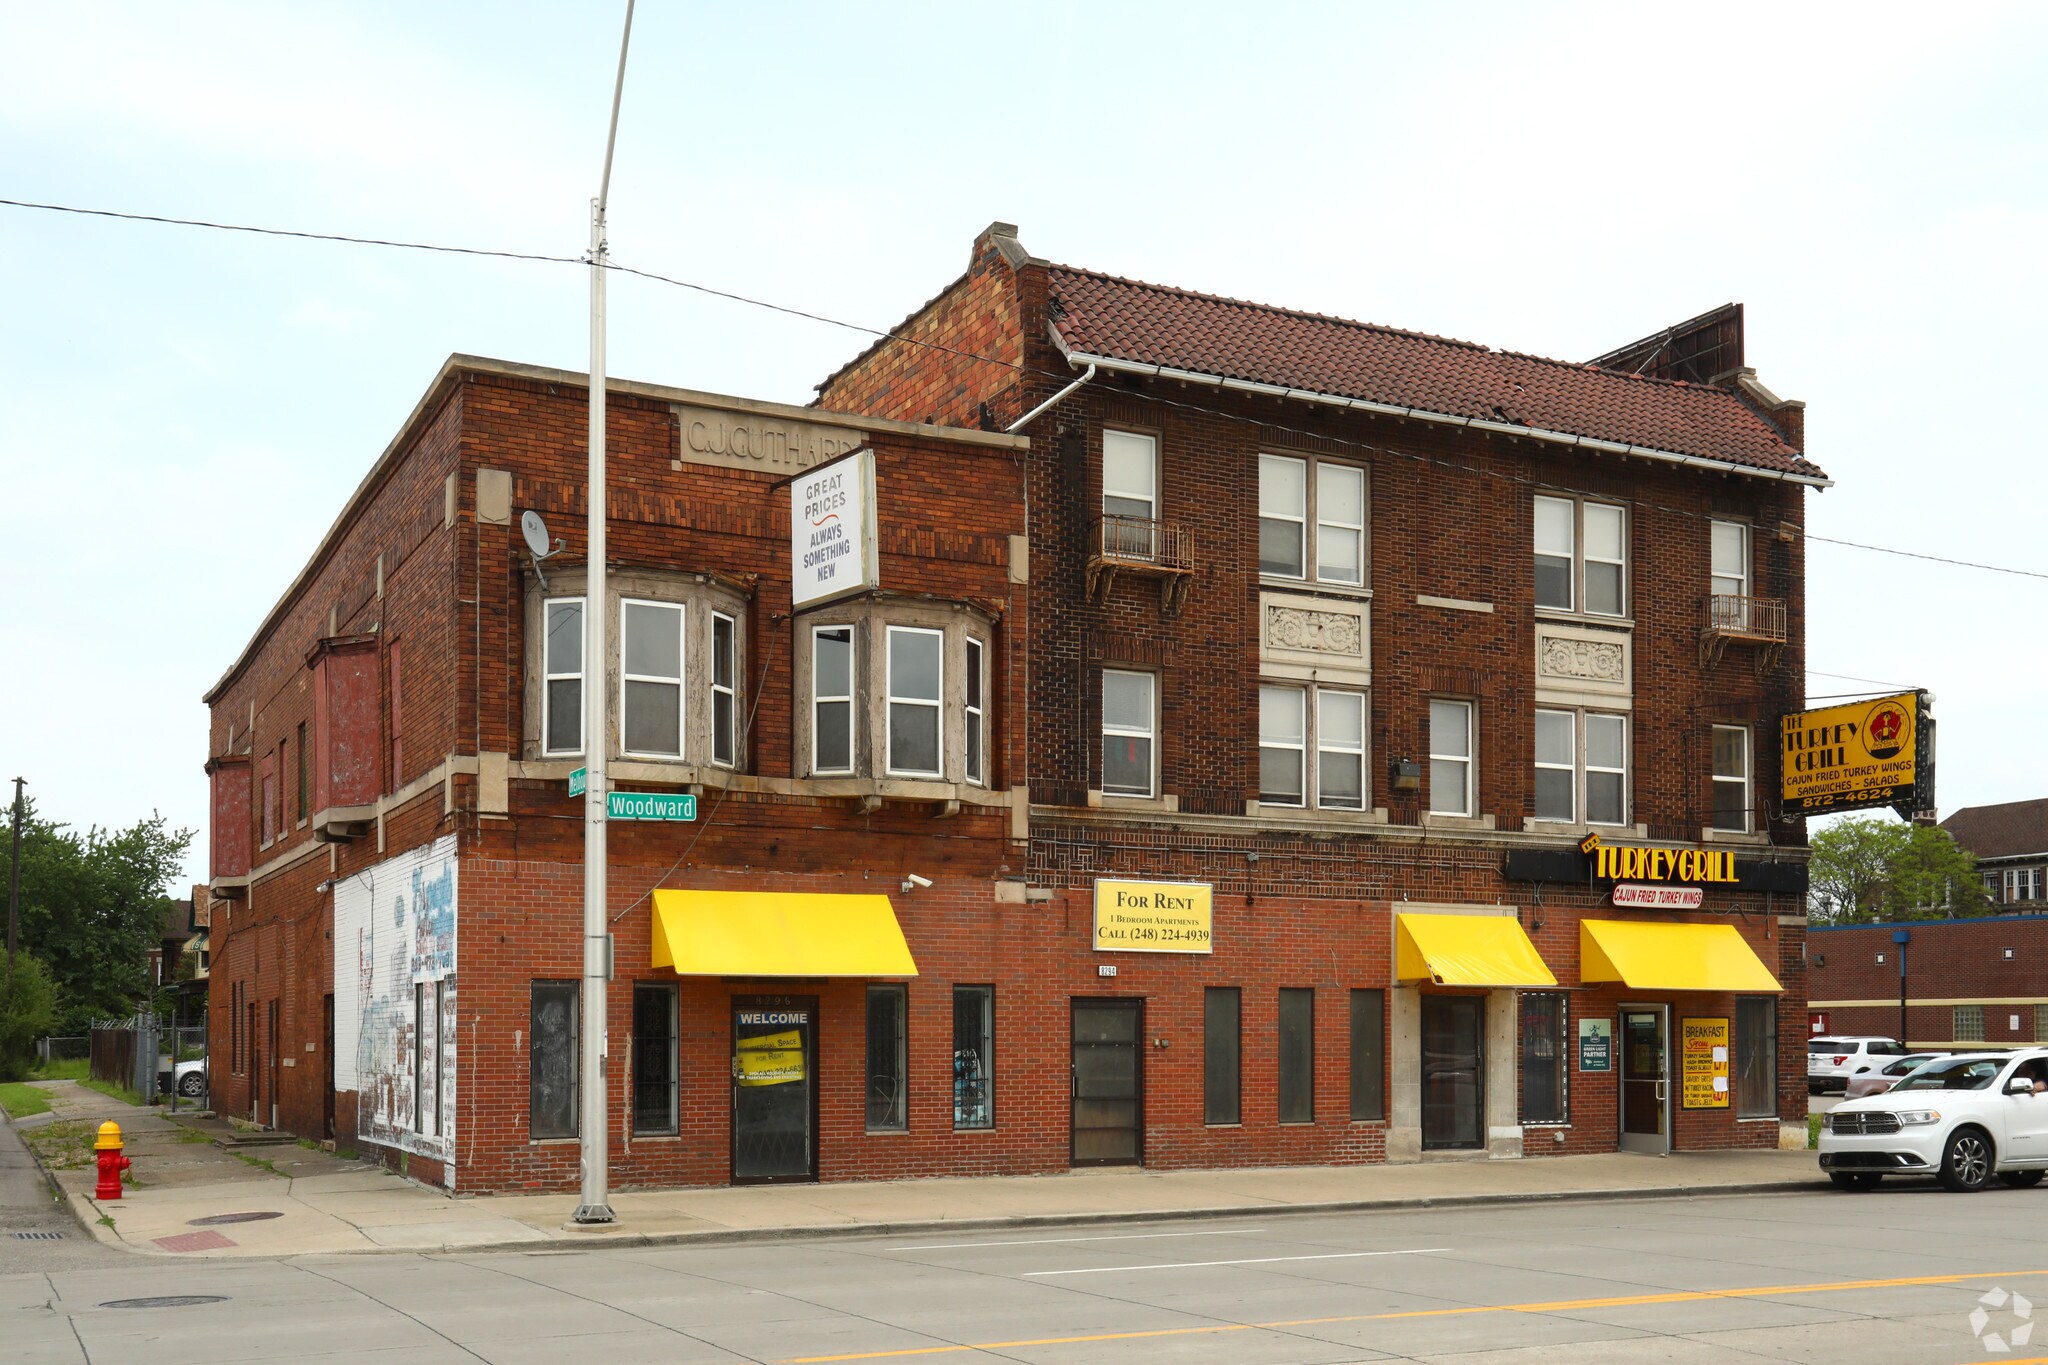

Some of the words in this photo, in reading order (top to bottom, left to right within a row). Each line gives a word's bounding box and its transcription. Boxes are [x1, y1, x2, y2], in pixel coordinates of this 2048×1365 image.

[806, 473, 843, 500] GREAT
[805, 491, 846, 520] PRICES
[810, 523, 842, 549] ALWAYS
[803, 538, 850, 569] SOMETHING
[817, 562, 836, 582] NEW
[1787, 716, 1804, 731] THE
[1785, 721, 1861, 752] TURKEY
[1795, 746, 1850, 772] GRILL
[1786, 773, 1813, 786] CAJUN
[1815, 769, 1840, 782] FRIED
[1843, 764, 1878, 778] TURKEY
[1881, 760, 1912, 773] WINGS
[1797, 780, 1852, 797] SANDWICHES
[1863, 774, 1900, 788] SALADS
[612, 797, 692, 817] Woodward
[1802, 787, 1894, 808] 872-4624
[1117, 891, 1148, 908] FOR
[1154, 893, 1194, 910] RENT
[1614, 888, 1637, 902] CAJUN
[1638, 889, 1656, 903] FRIED
[1658, 891, 1684, 905] TURKEY
[1683, 893, 1702, 905] WINGS
[1098, 926, 1127, 939] CALL
[1130, 928, 1158, 942] (248)
[1161, 929, 1209, 941] 224-4939
[740, 1013, 807, 1024] WELCOME
[1685, 1026, 1725, 1037] BREAKFAST
